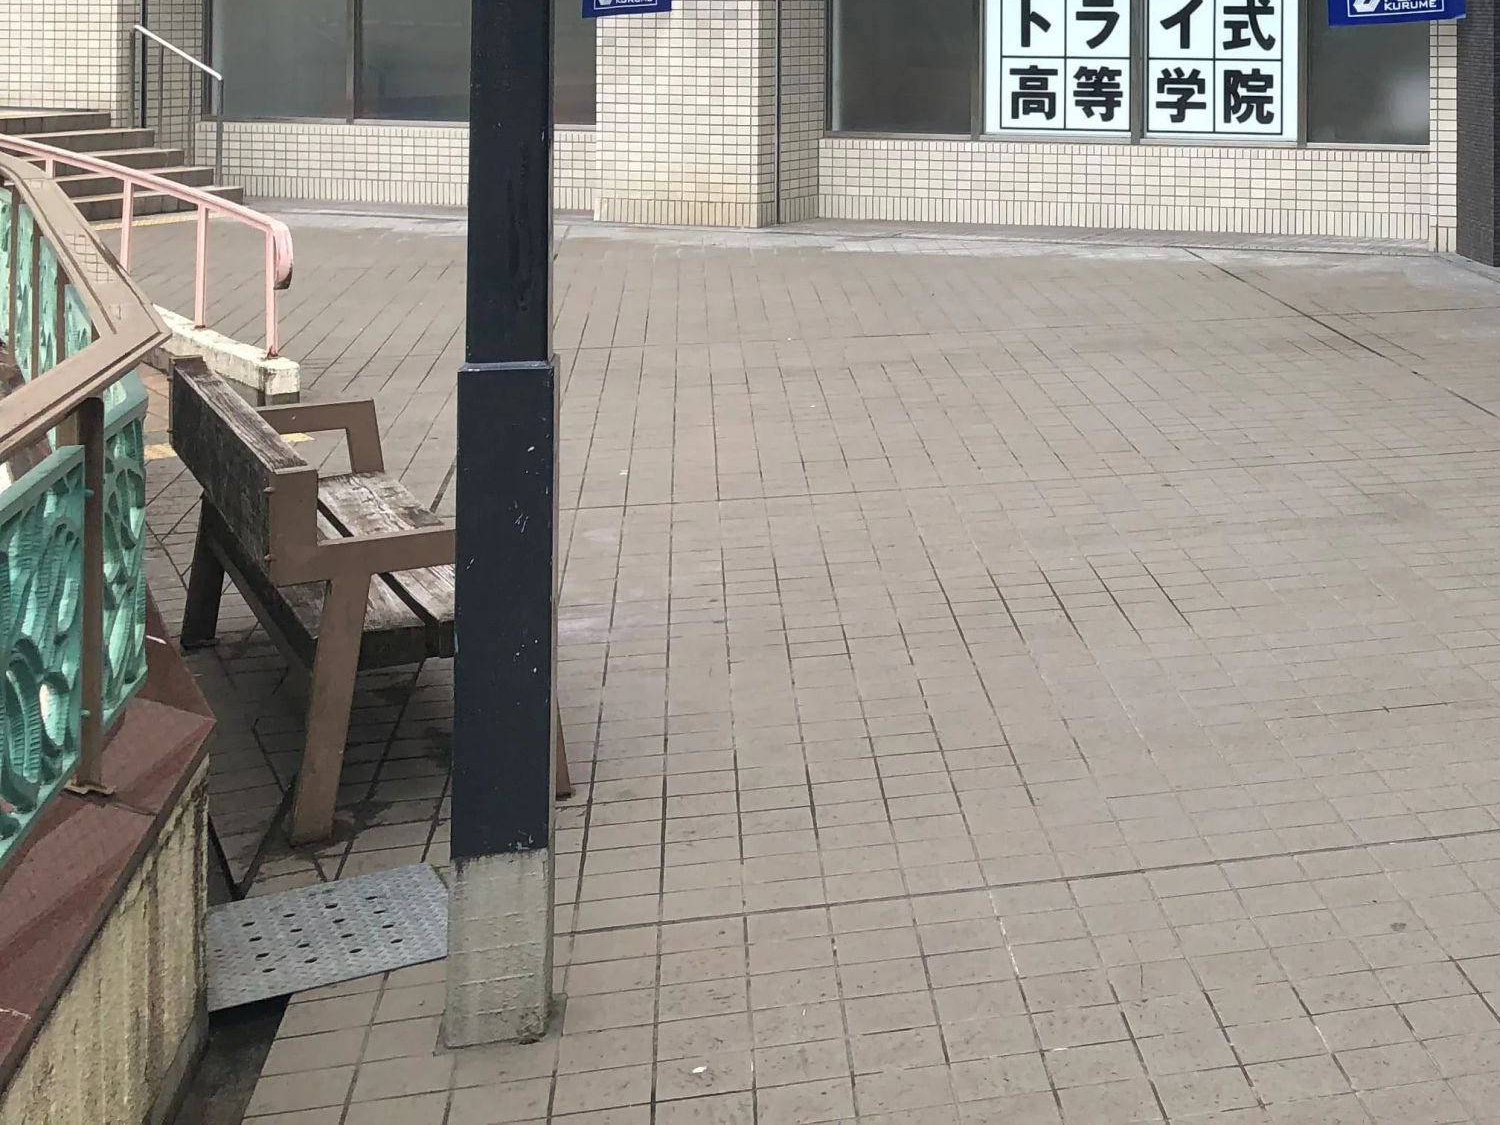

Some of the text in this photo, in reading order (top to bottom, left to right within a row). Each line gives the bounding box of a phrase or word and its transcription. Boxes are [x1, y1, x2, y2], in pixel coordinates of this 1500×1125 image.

[1384, 0, 1437, 11] KURUME
[1010, 65, 1275, 125] 高等学院
